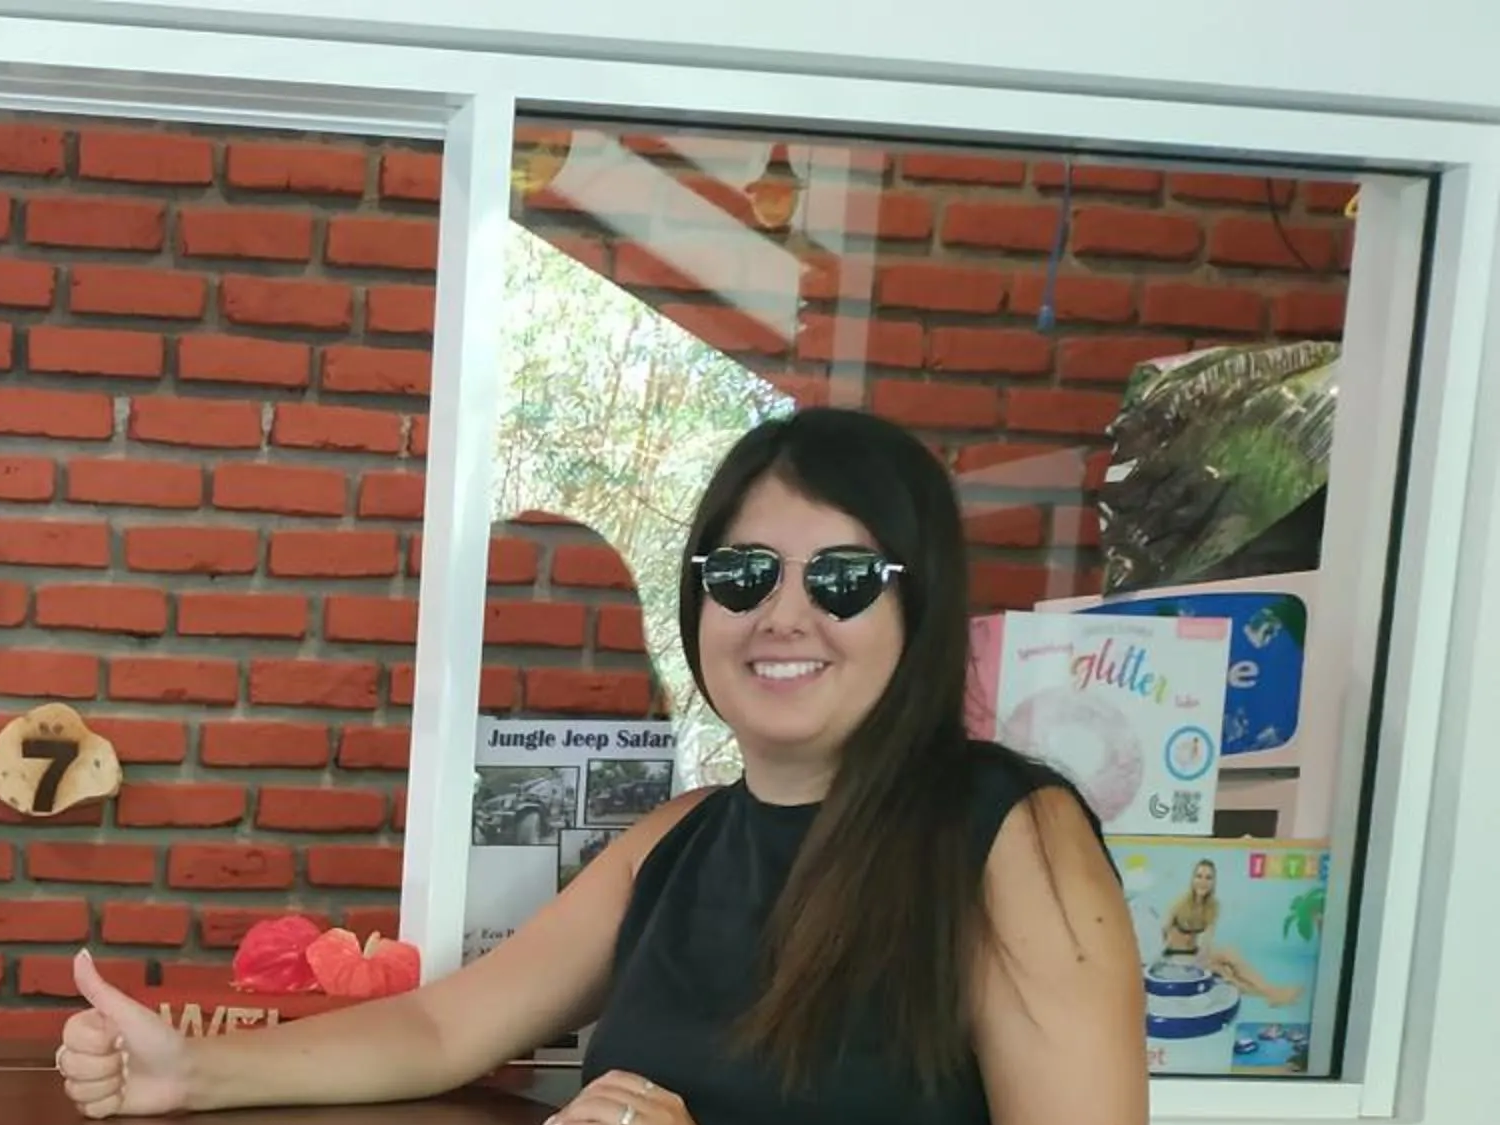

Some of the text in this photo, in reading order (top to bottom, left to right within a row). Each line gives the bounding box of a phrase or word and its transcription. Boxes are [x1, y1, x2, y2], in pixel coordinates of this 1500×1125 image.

[1071, 637, 1169, 703] glitter
[488, 729, 556, 750] Jungle
[561, 729, 610, 750] Jeep
[22, 739, 79, 812] 7
